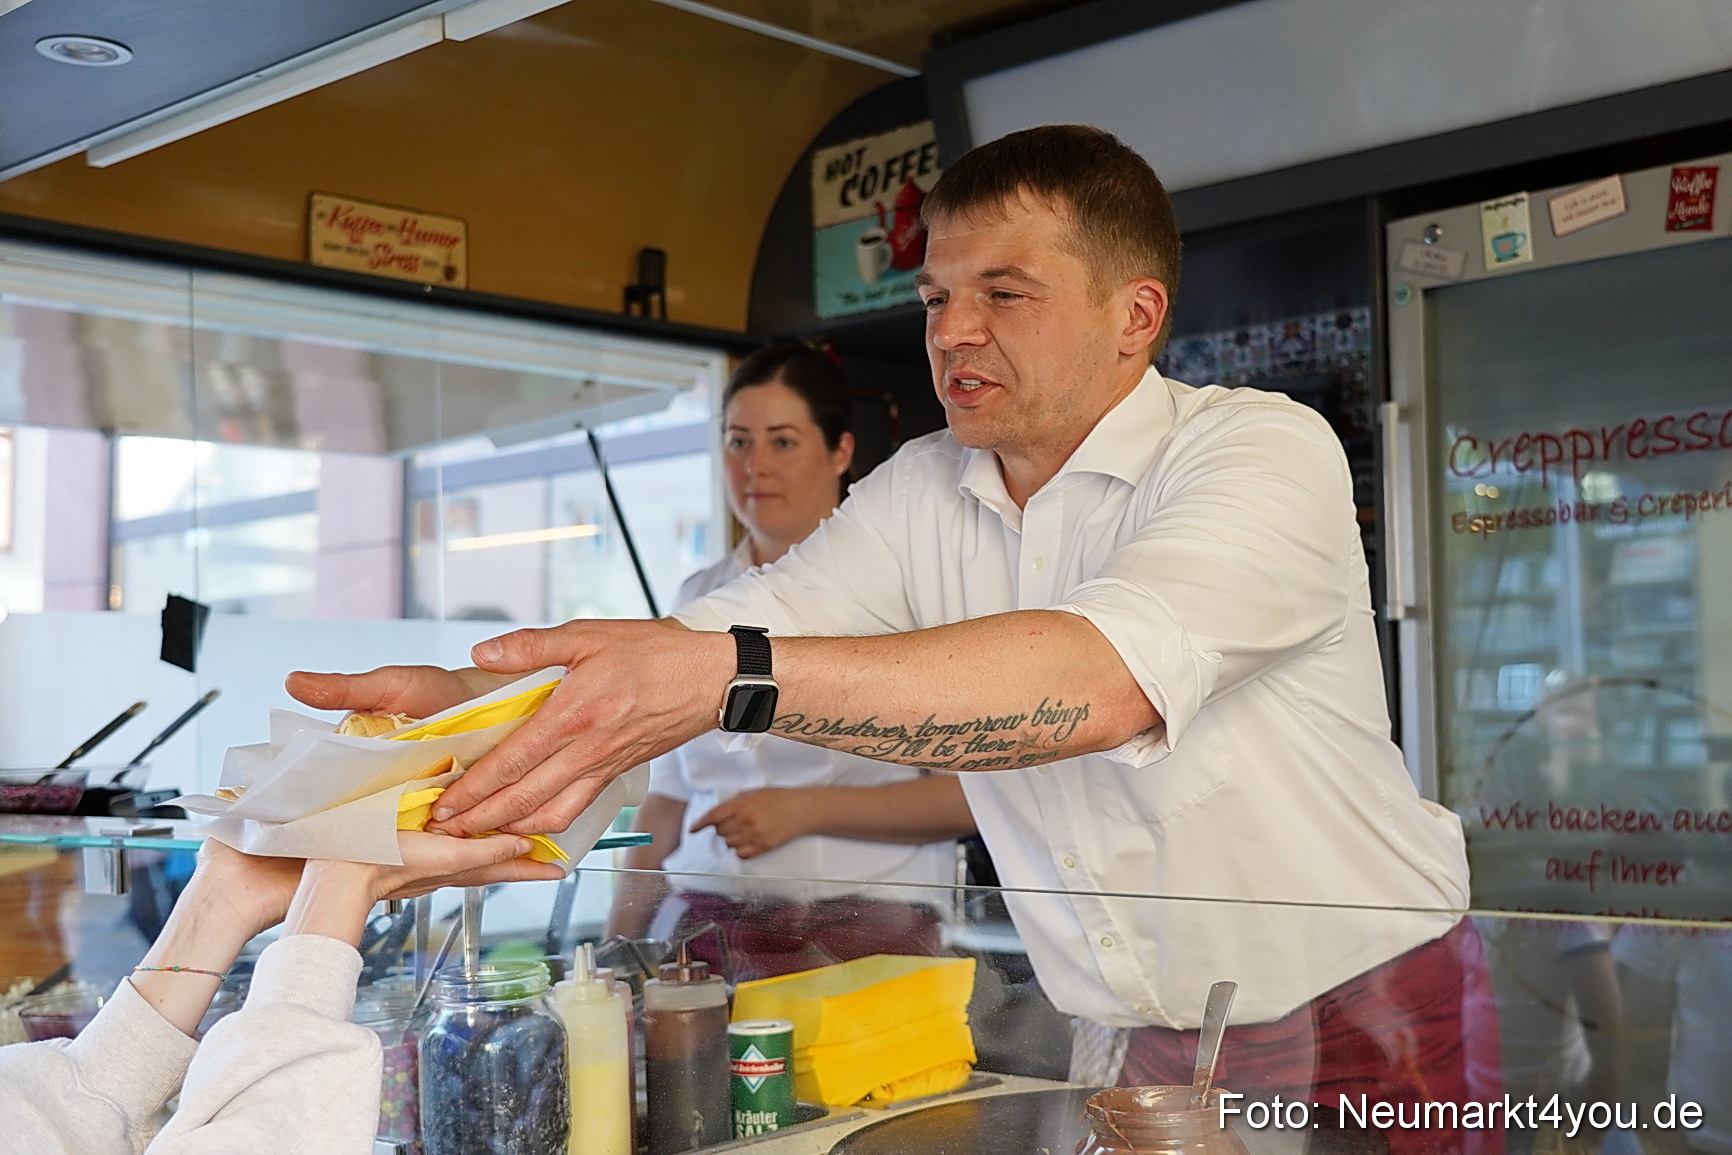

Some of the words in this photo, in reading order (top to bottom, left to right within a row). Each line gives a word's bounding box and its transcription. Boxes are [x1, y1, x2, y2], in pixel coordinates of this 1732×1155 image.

[824, 146, 867, 182] HOT
[839, 141, 941, 208] COFFE
[1451, 499, 1599, 541] Espressobar
[912, 712, 1028, 739] tomorrow
[1030, 697, 1091, 742] brings
[930, 735, 958, 758] be
[1479, 801, 1539, 831] Wir
[1548, 801, 1662, 833] backen
[1545, 849, 1603, 892] auf
[1611, 856, 1688, 885] Ihrer
[734, 1109, 778, 1125] Kräuter
